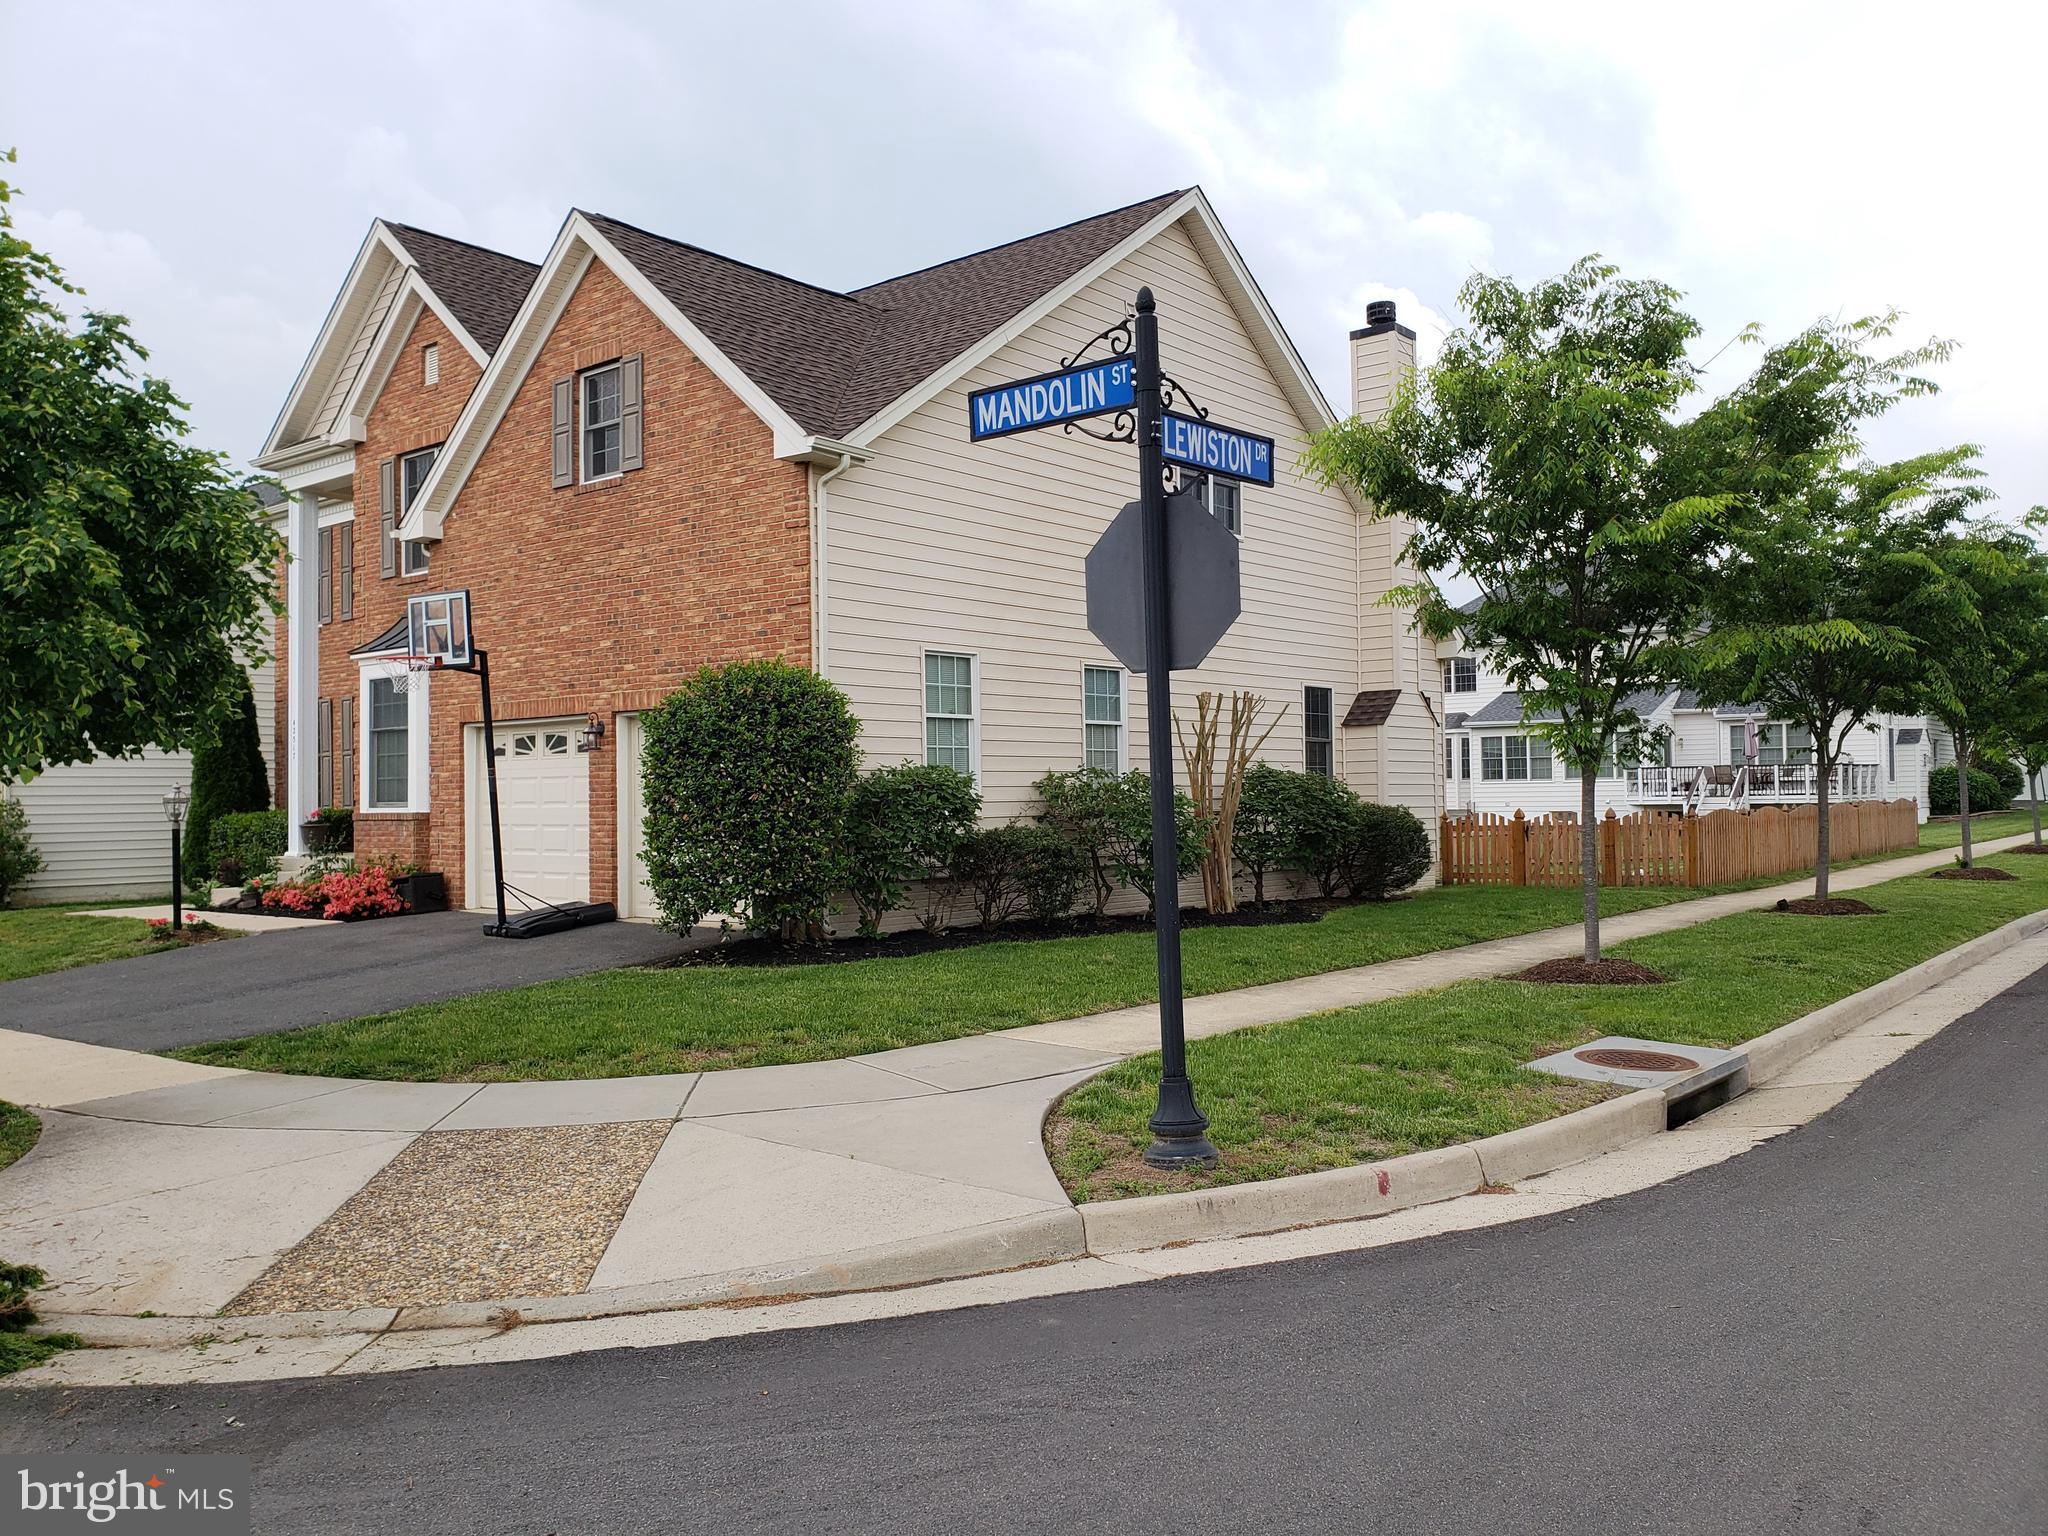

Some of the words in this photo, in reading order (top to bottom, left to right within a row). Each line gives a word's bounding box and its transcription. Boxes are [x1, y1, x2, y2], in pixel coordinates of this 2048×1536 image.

[977, 369, 1106, 433] MANDOLIN
[1111, 363, 1129, 386] ST
[1163, 417, 1252, 475] LEWISTON
[1255, 441, 1268, 463] DR
